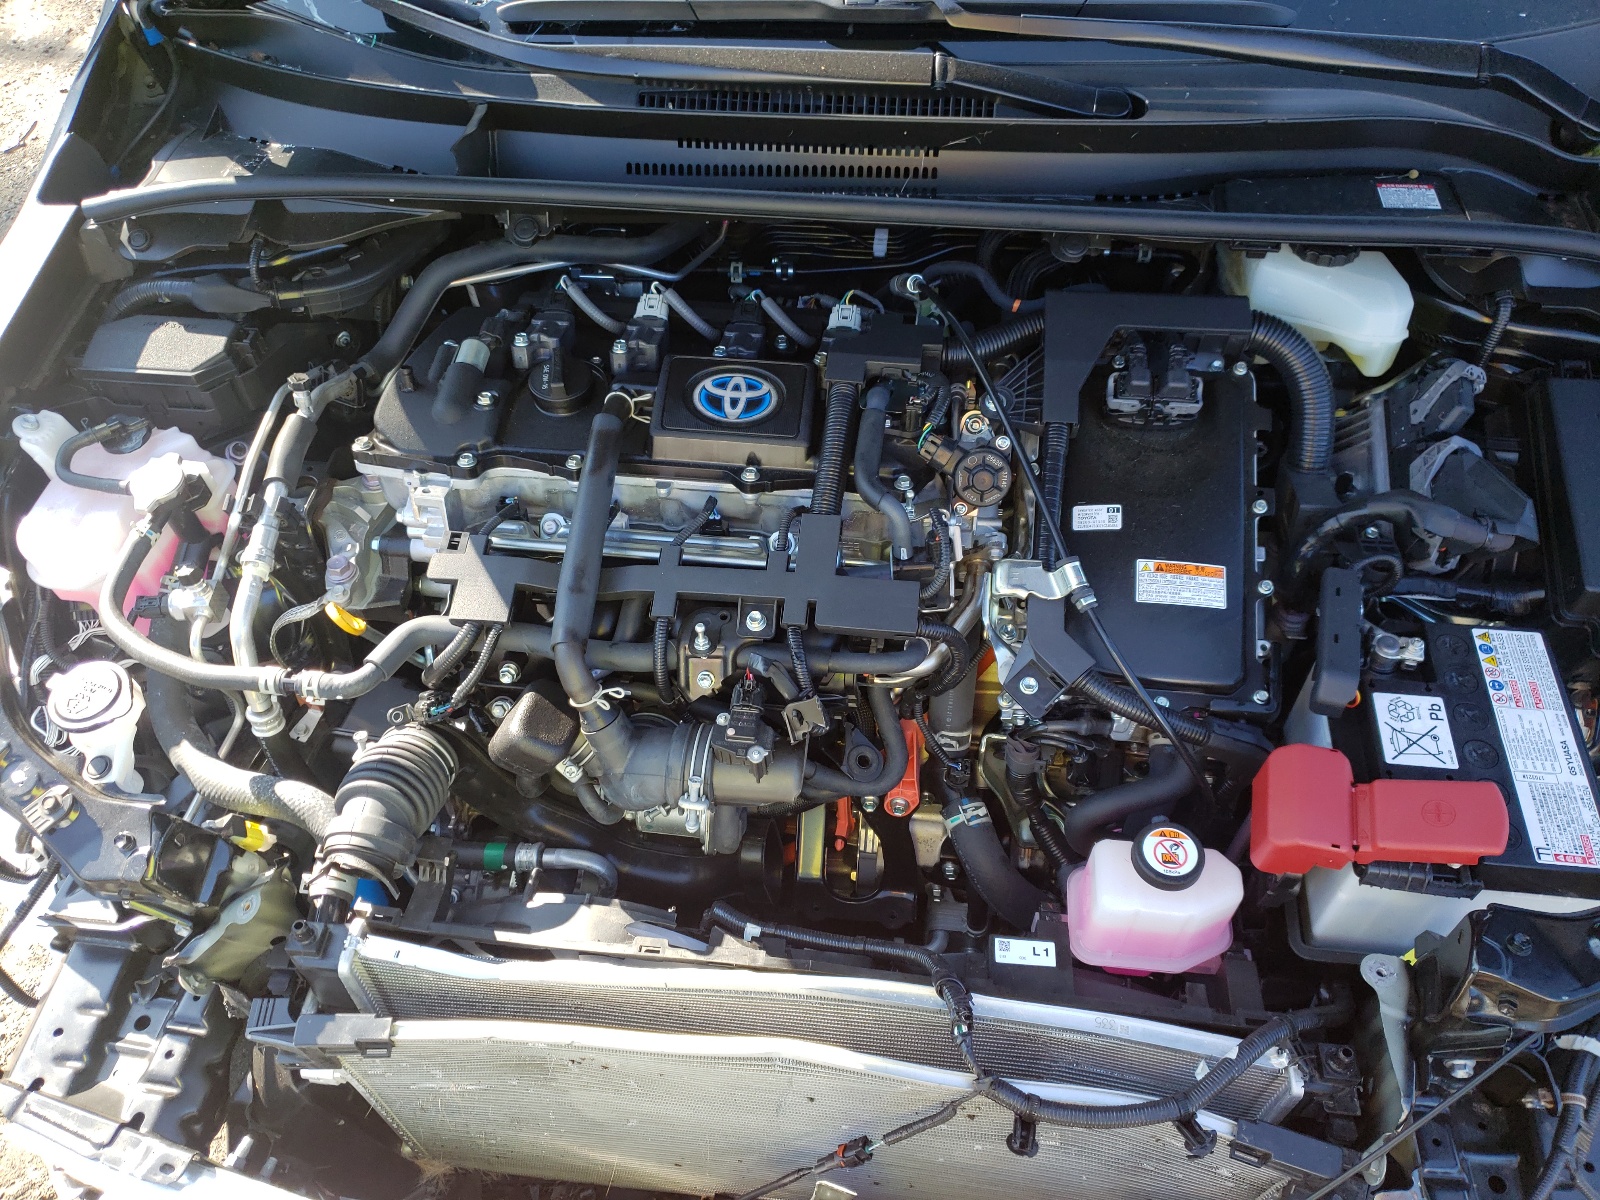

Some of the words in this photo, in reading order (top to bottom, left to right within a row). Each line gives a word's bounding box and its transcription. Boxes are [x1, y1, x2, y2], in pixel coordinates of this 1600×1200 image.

[1428, 703, 1445, 722] Pb
[1560, 740, 1574, 765] YUASA
[1568, 766, 1577, 776] GS
[1581, 835, 1594, 857] DANGER
[1032, 946, 1049, 957] L1
